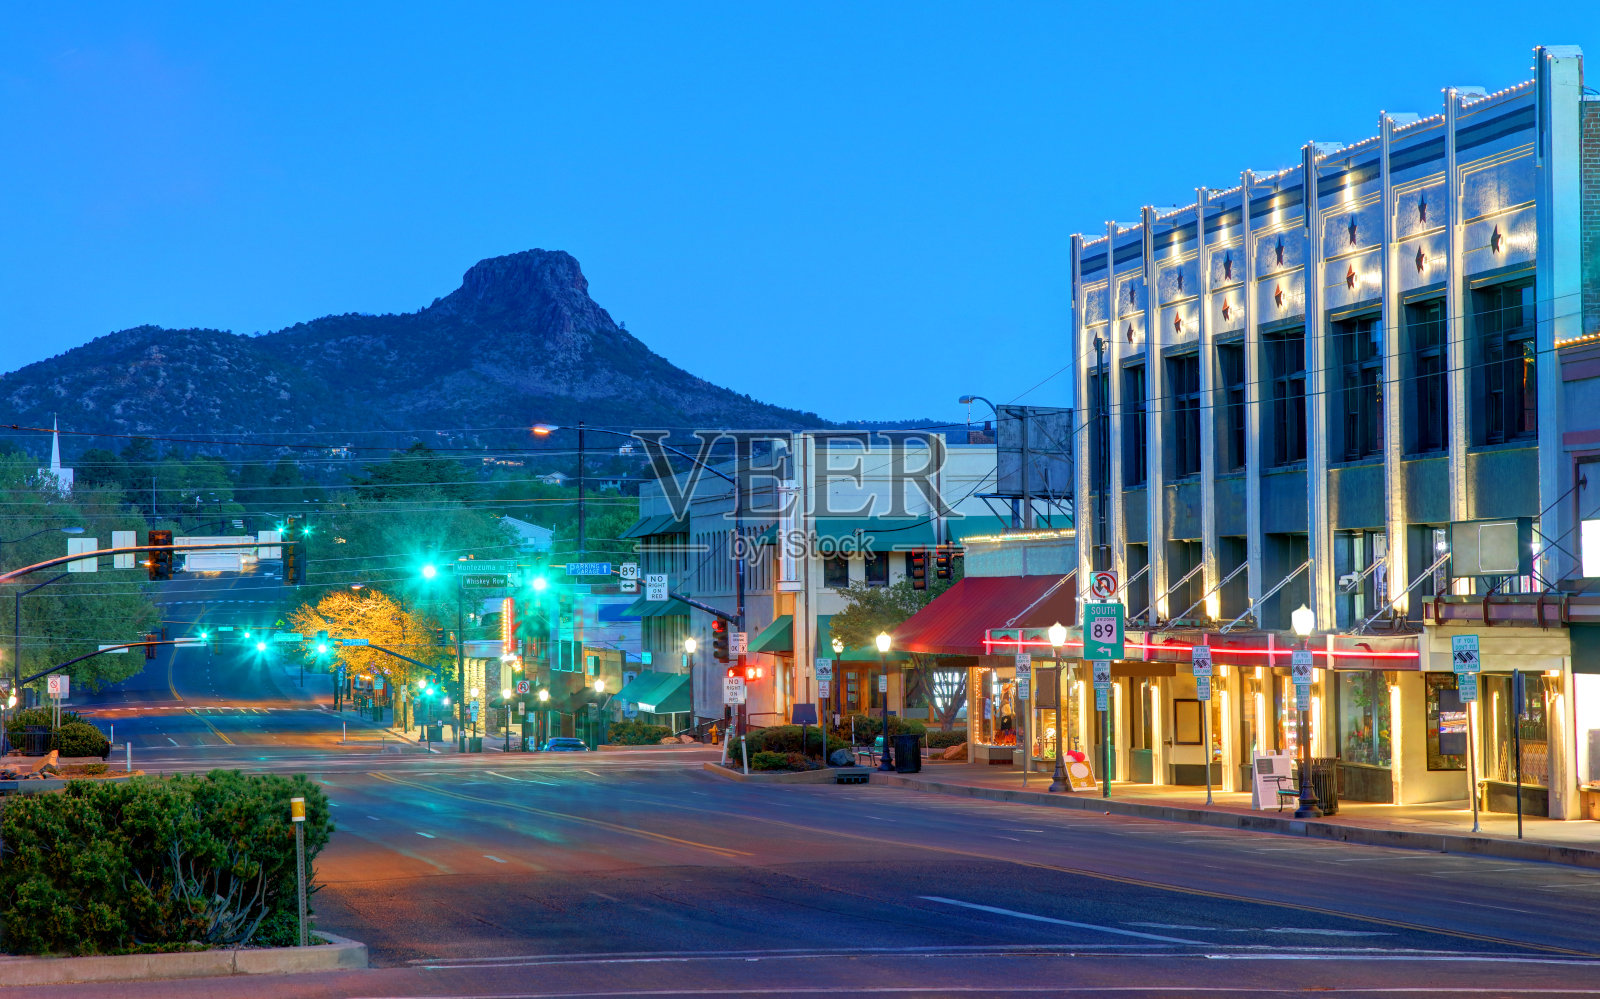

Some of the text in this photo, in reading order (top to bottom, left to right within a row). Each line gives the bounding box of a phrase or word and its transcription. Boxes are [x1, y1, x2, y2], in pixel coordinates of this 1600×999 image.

[569, 563, 600, 572] PARKING
[622, 567, 635, 576] 89
[466, 578, 490, 586] Whiskey
[1091, 606, 1116, 615] SOUTH
[1094, 624, 1114, 638] 89
